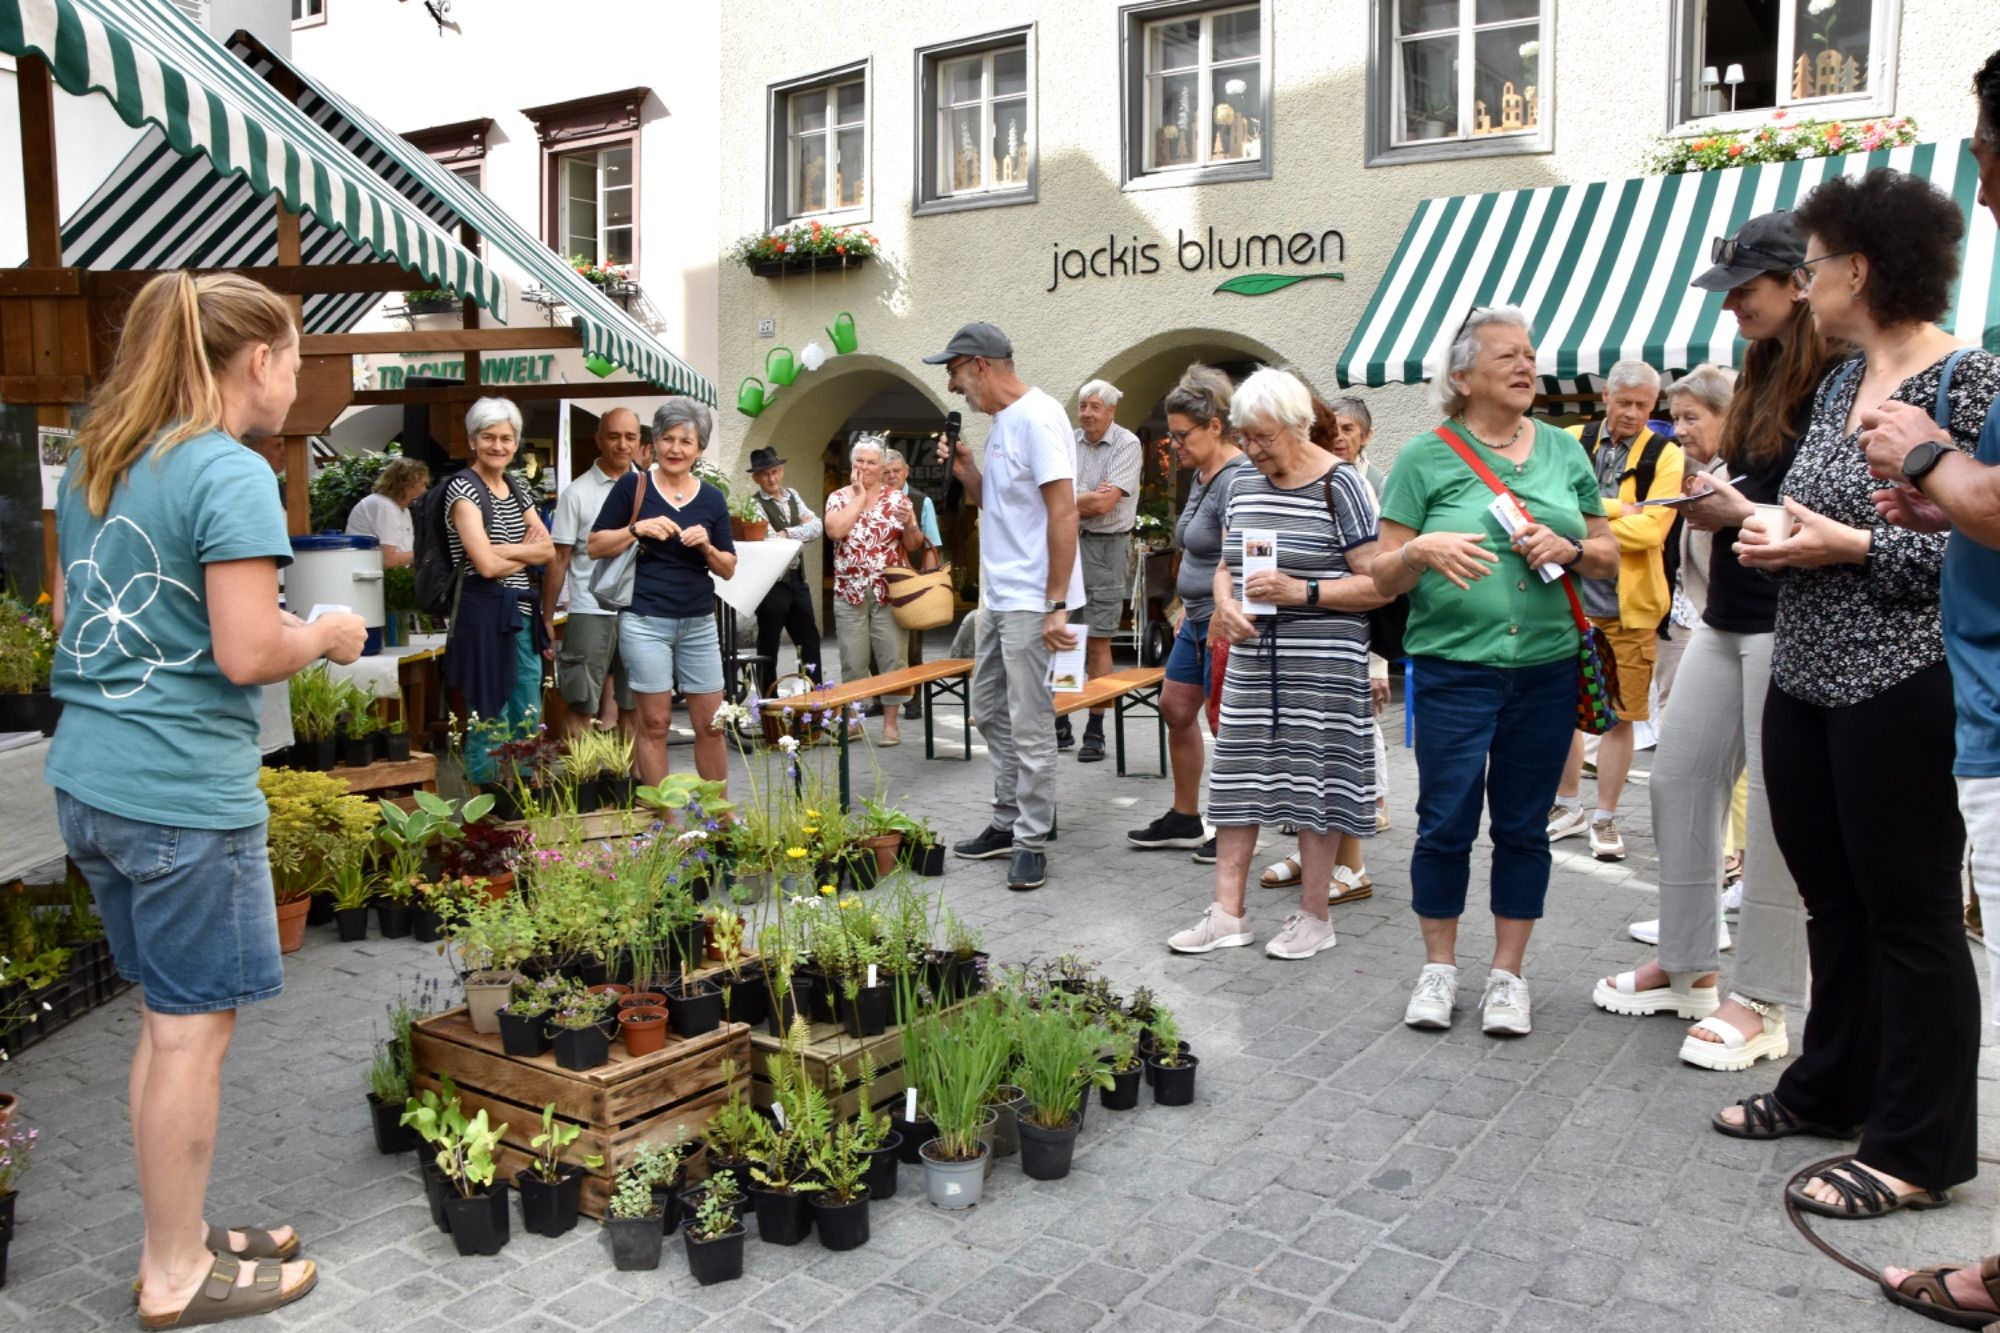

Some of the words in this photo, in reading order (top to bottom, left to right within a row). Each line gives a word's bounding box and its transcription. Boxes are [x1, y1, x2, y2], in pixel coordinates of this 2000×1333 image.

[1047, 234, 1160, 292] jackis
[1178, 226, 1345, 272] blumen
[760, 320, 771, 332] 27
[377, 353, 555, 390] TRACHTNWELT
[894, 439, 938, 466] 1/2
